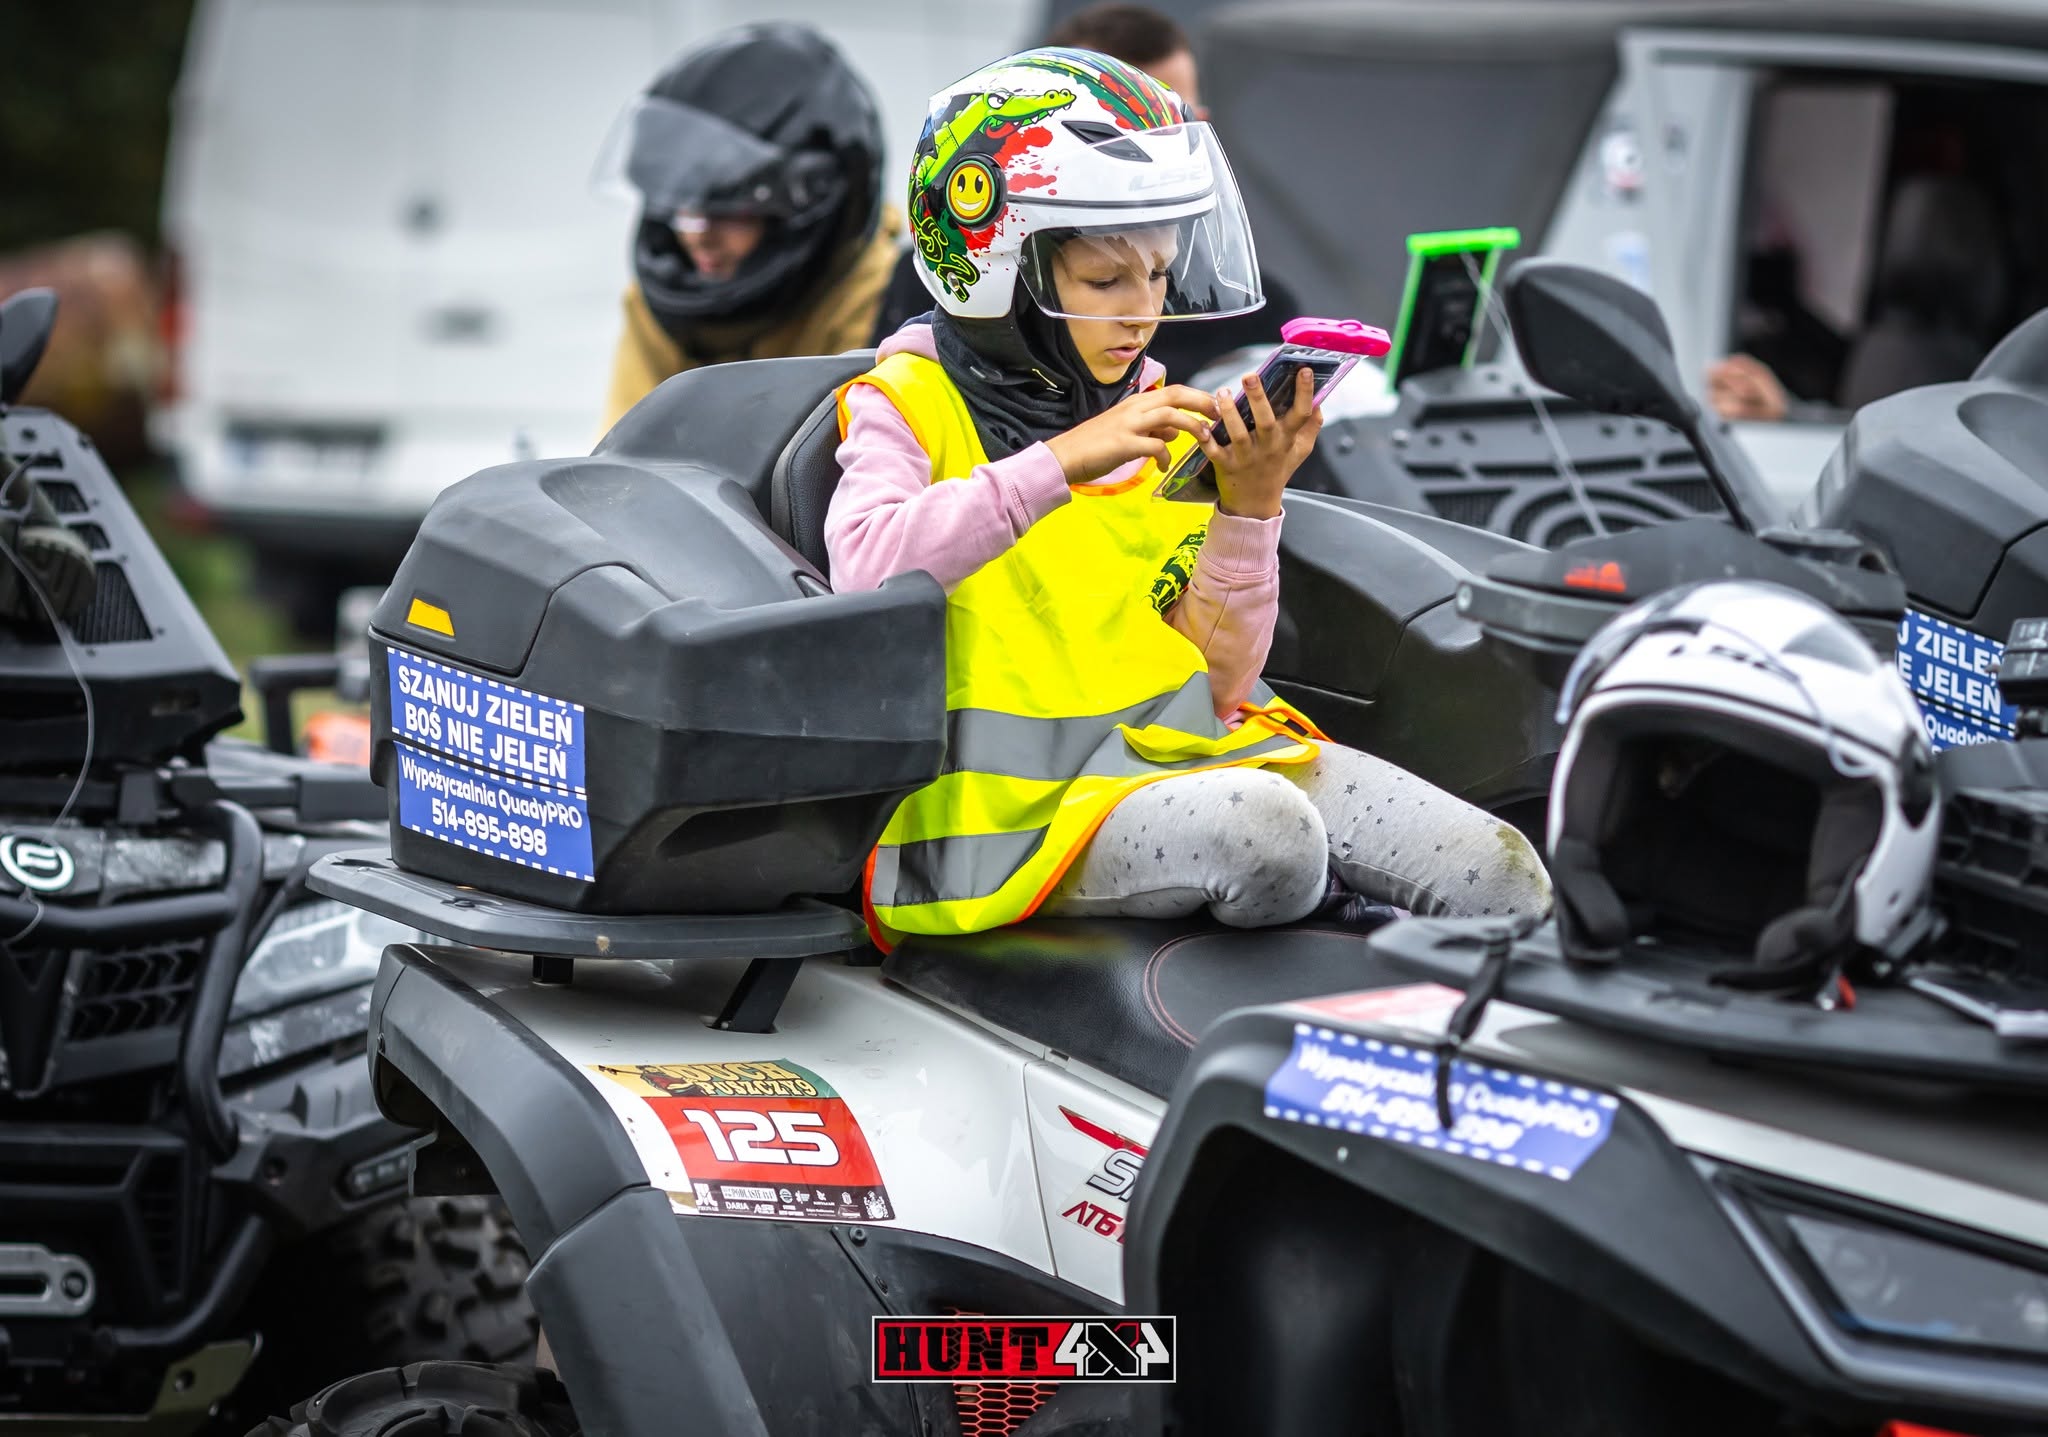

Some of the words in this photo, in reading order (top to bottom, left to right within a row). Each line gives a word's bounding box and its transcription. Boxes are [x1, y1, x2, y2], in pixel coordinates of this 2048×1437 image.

[399, 665, 479, 717] SZANUJ
[485, 693, 572, 745] ZIELEŃ
[1919, 663, 2001, 715] JELEŃ
[405, 702, 441, 740] BOŚ
[447, 717, 483, 756] NIE
[490, 733, 566, 779] JELEŃ
[401, 755, 496, 808] Wypożyczalnia
[499, 789, 582, 829] QuadyPRO
[432, 797, 547, 857] 514-895-898
[663, 1063, 801, 1082] DUCH
[682, 1108, 840, 1167] 125
[725, 1201, 749, 1210] DARIA
[1086, 1150, 1145, 1203] S
